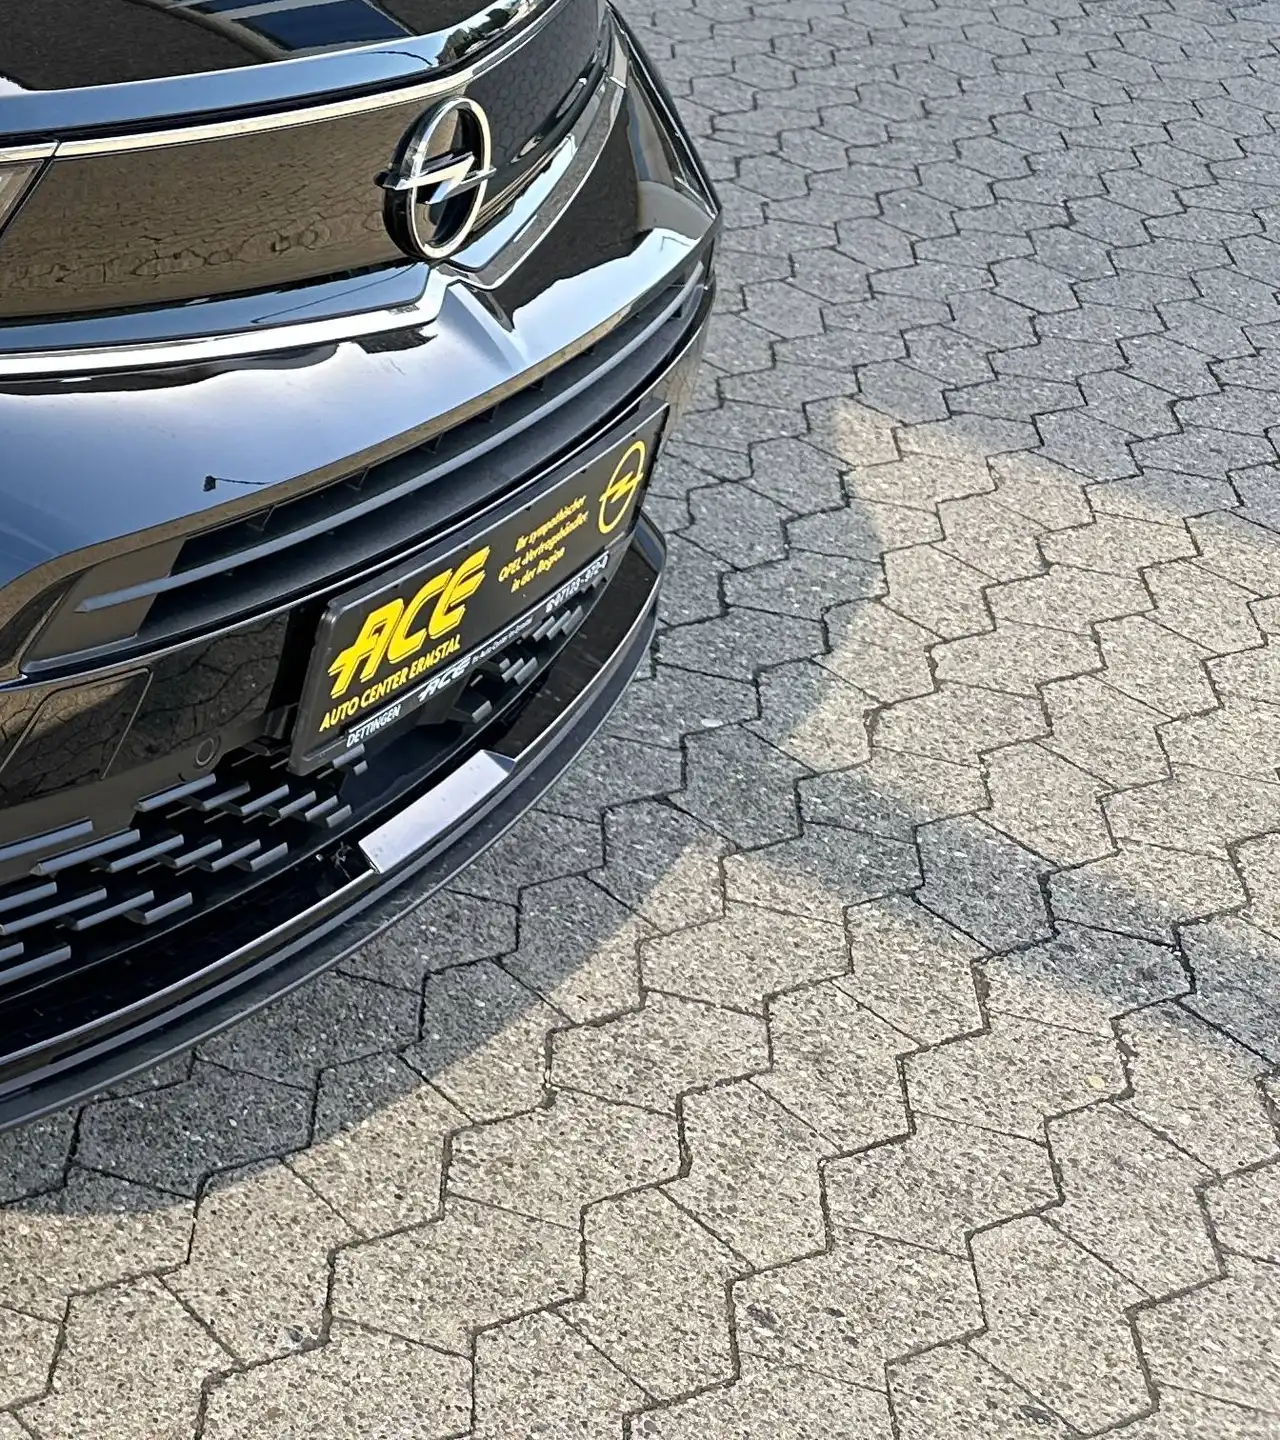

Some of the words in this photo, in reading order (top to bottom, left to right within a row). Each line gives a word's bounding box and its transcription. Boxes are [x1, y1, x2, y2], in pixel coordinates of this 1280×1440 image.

[327, 545, 490, 699] ACE
[319, 695, 360, 732] AUTO
[360, 667, 409, 708] CENTER
[408, 634, 461, 683] ERMSTAL
[346, 705, 402, 748] DETTINGEN
